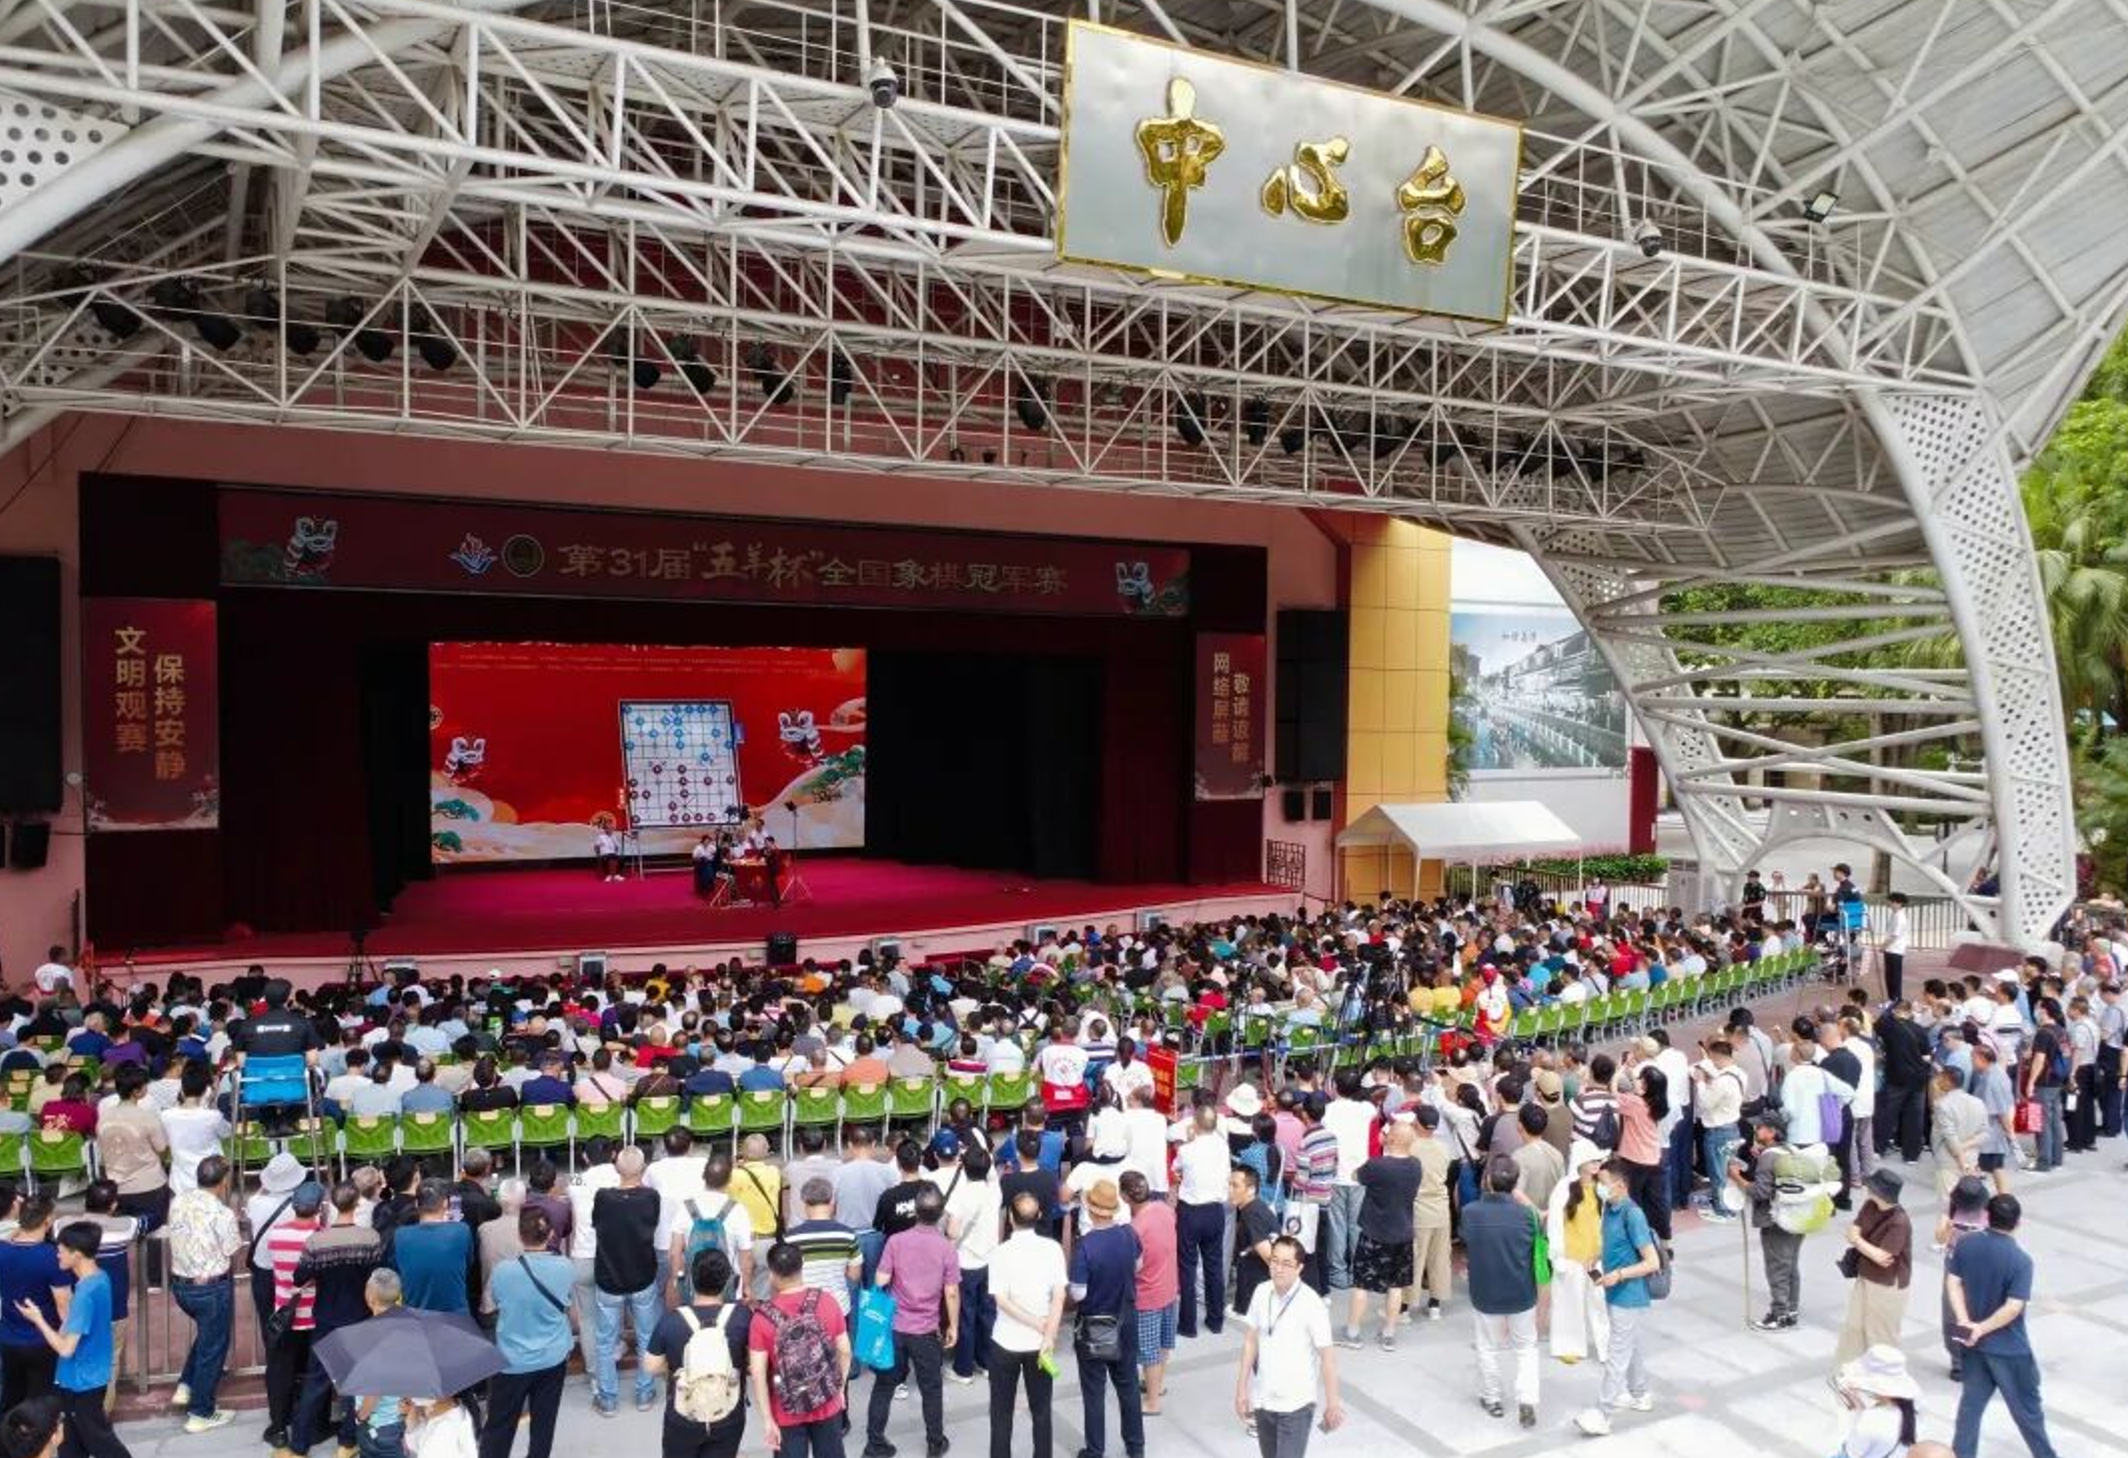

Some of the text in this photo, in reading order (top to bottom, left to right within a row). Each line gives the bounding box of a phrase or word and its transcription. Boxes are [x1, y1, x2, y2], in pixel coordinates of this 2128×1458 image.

[1134, 75, 1468, 266] 中心台
[115, 626, 147, 753] 文明观赛
[154, 654, 187, 780] 保持安静
